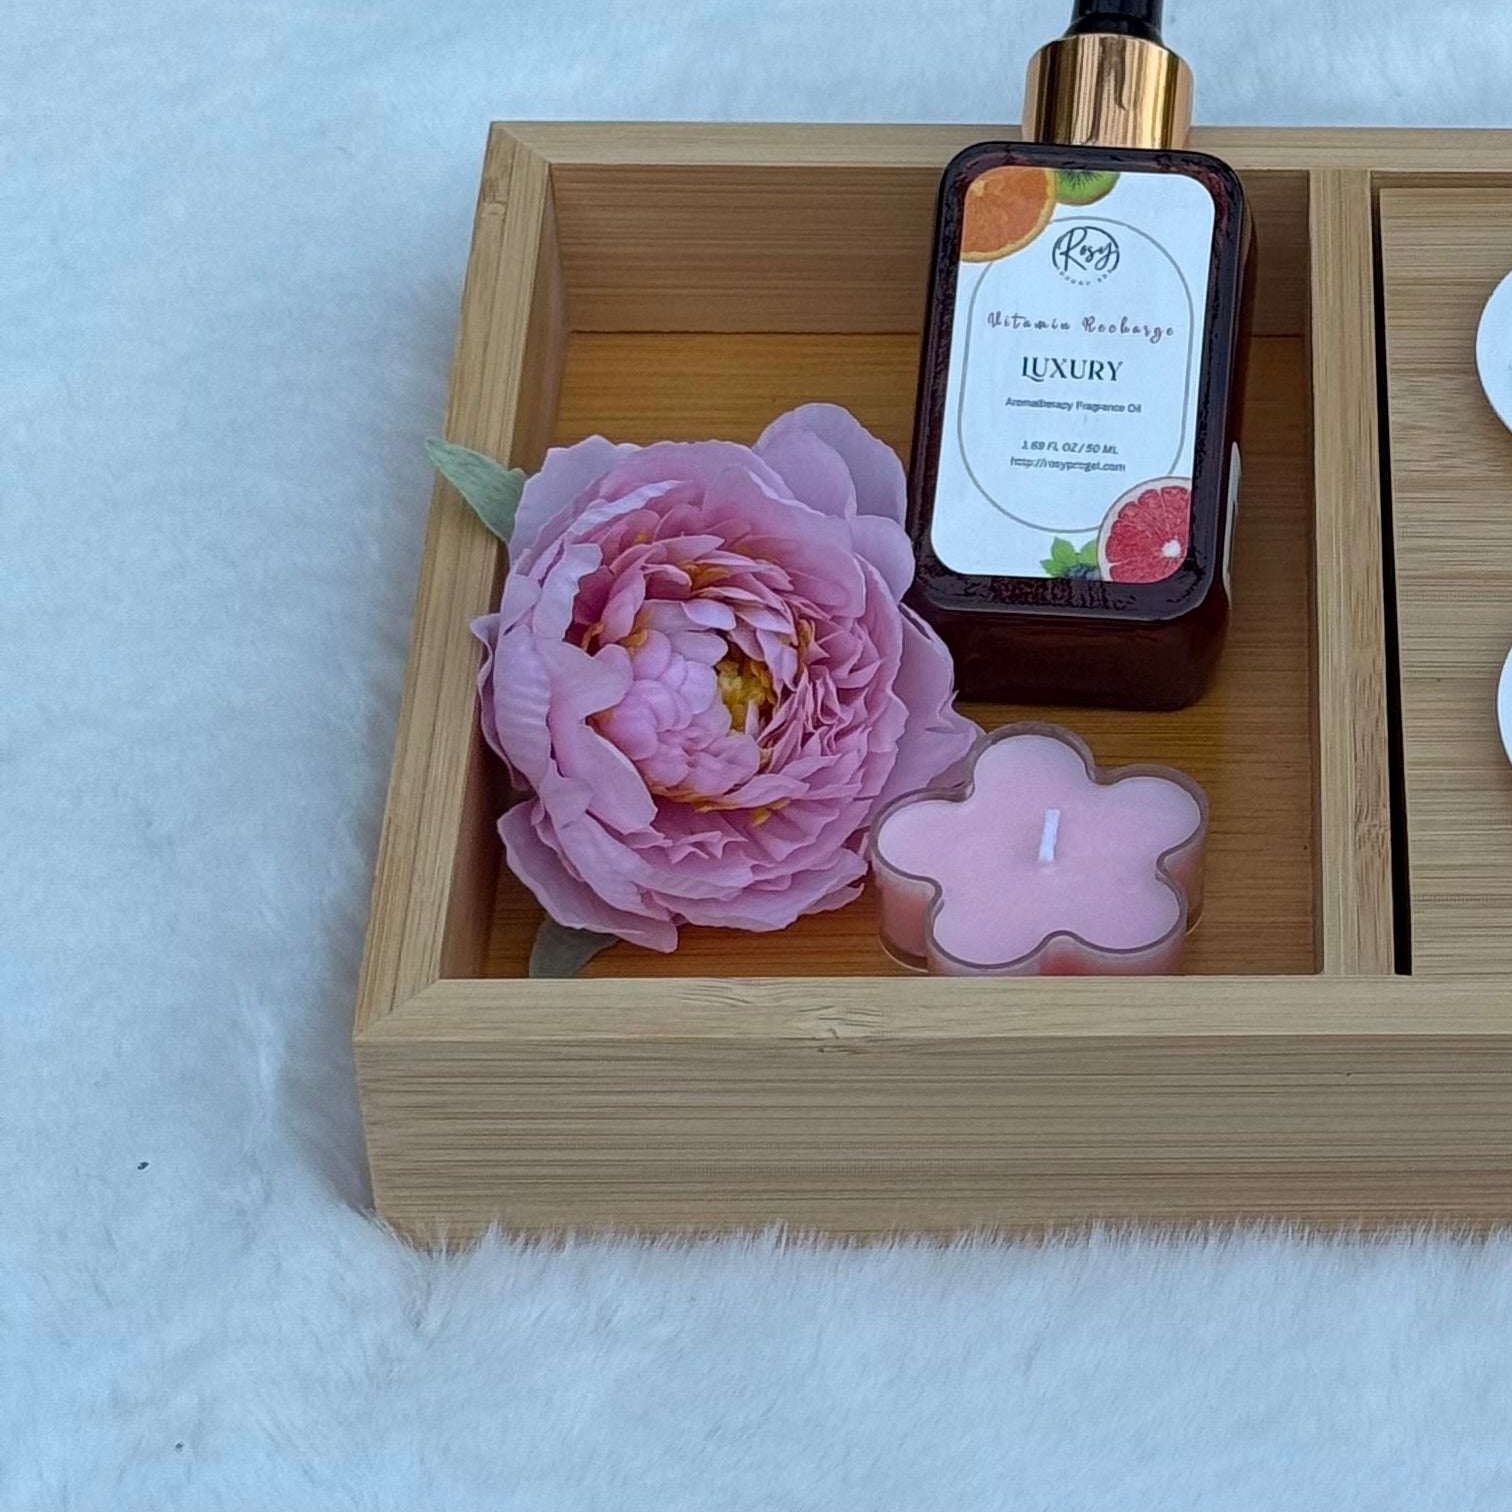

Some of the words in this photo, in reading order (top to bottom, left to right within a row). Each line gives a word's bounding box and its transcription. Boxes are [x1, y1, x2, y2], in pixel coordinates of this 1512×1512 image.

[1055, 226, 1119, 272] Rosy
[987, 310, 1071, 331] Vitamin
[1081, 314, 1175, 345] Recharge
[1020, 356, 1124, 383] LUXURY
[1004, 396, 1074, 412] Aromatherapy
[1075, 400, 1126, 414] Fragrance
[1127, 402, 1142, 414] Oil
[1046, 440, 1059, 453] FL
[1101, 443, 1120, 455] ML
